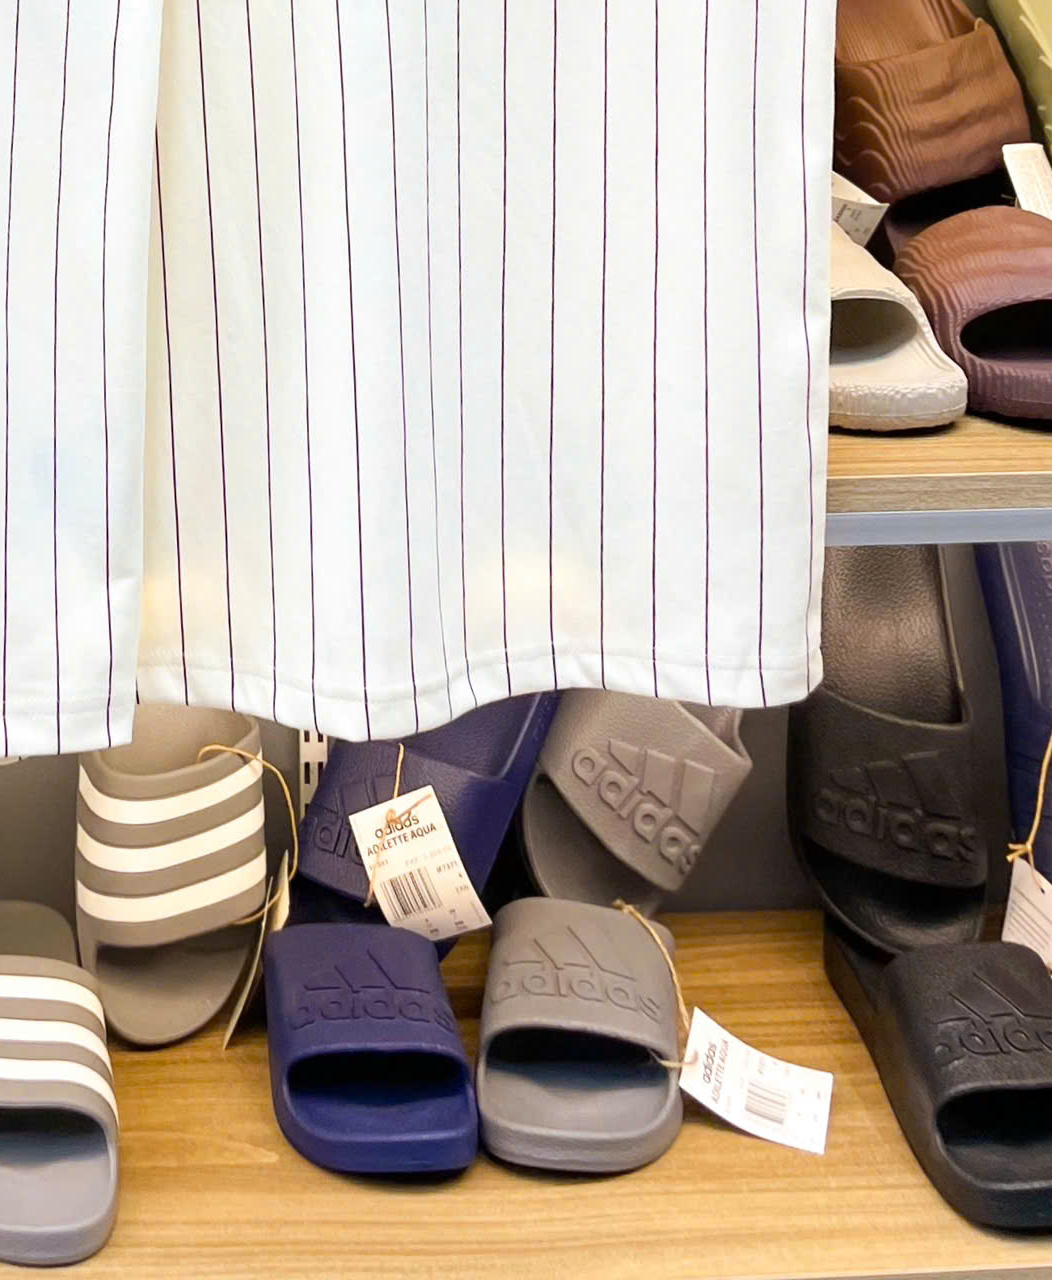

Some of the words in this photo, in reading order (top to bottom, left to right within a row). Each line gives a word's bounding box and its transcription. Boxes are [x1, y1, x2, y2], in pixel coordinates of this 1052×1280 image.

[375, 810, 420, 839] adidas
[410, 822, 437, 840] AQUA
[572, 746, 701, 875] adidas
[813, 786, 978, 863] adidas
[292, 990, 456, 1034] adidas
[491, 967, 663, 1024] adidas
[703, 1040, 717, 1084] adidas
